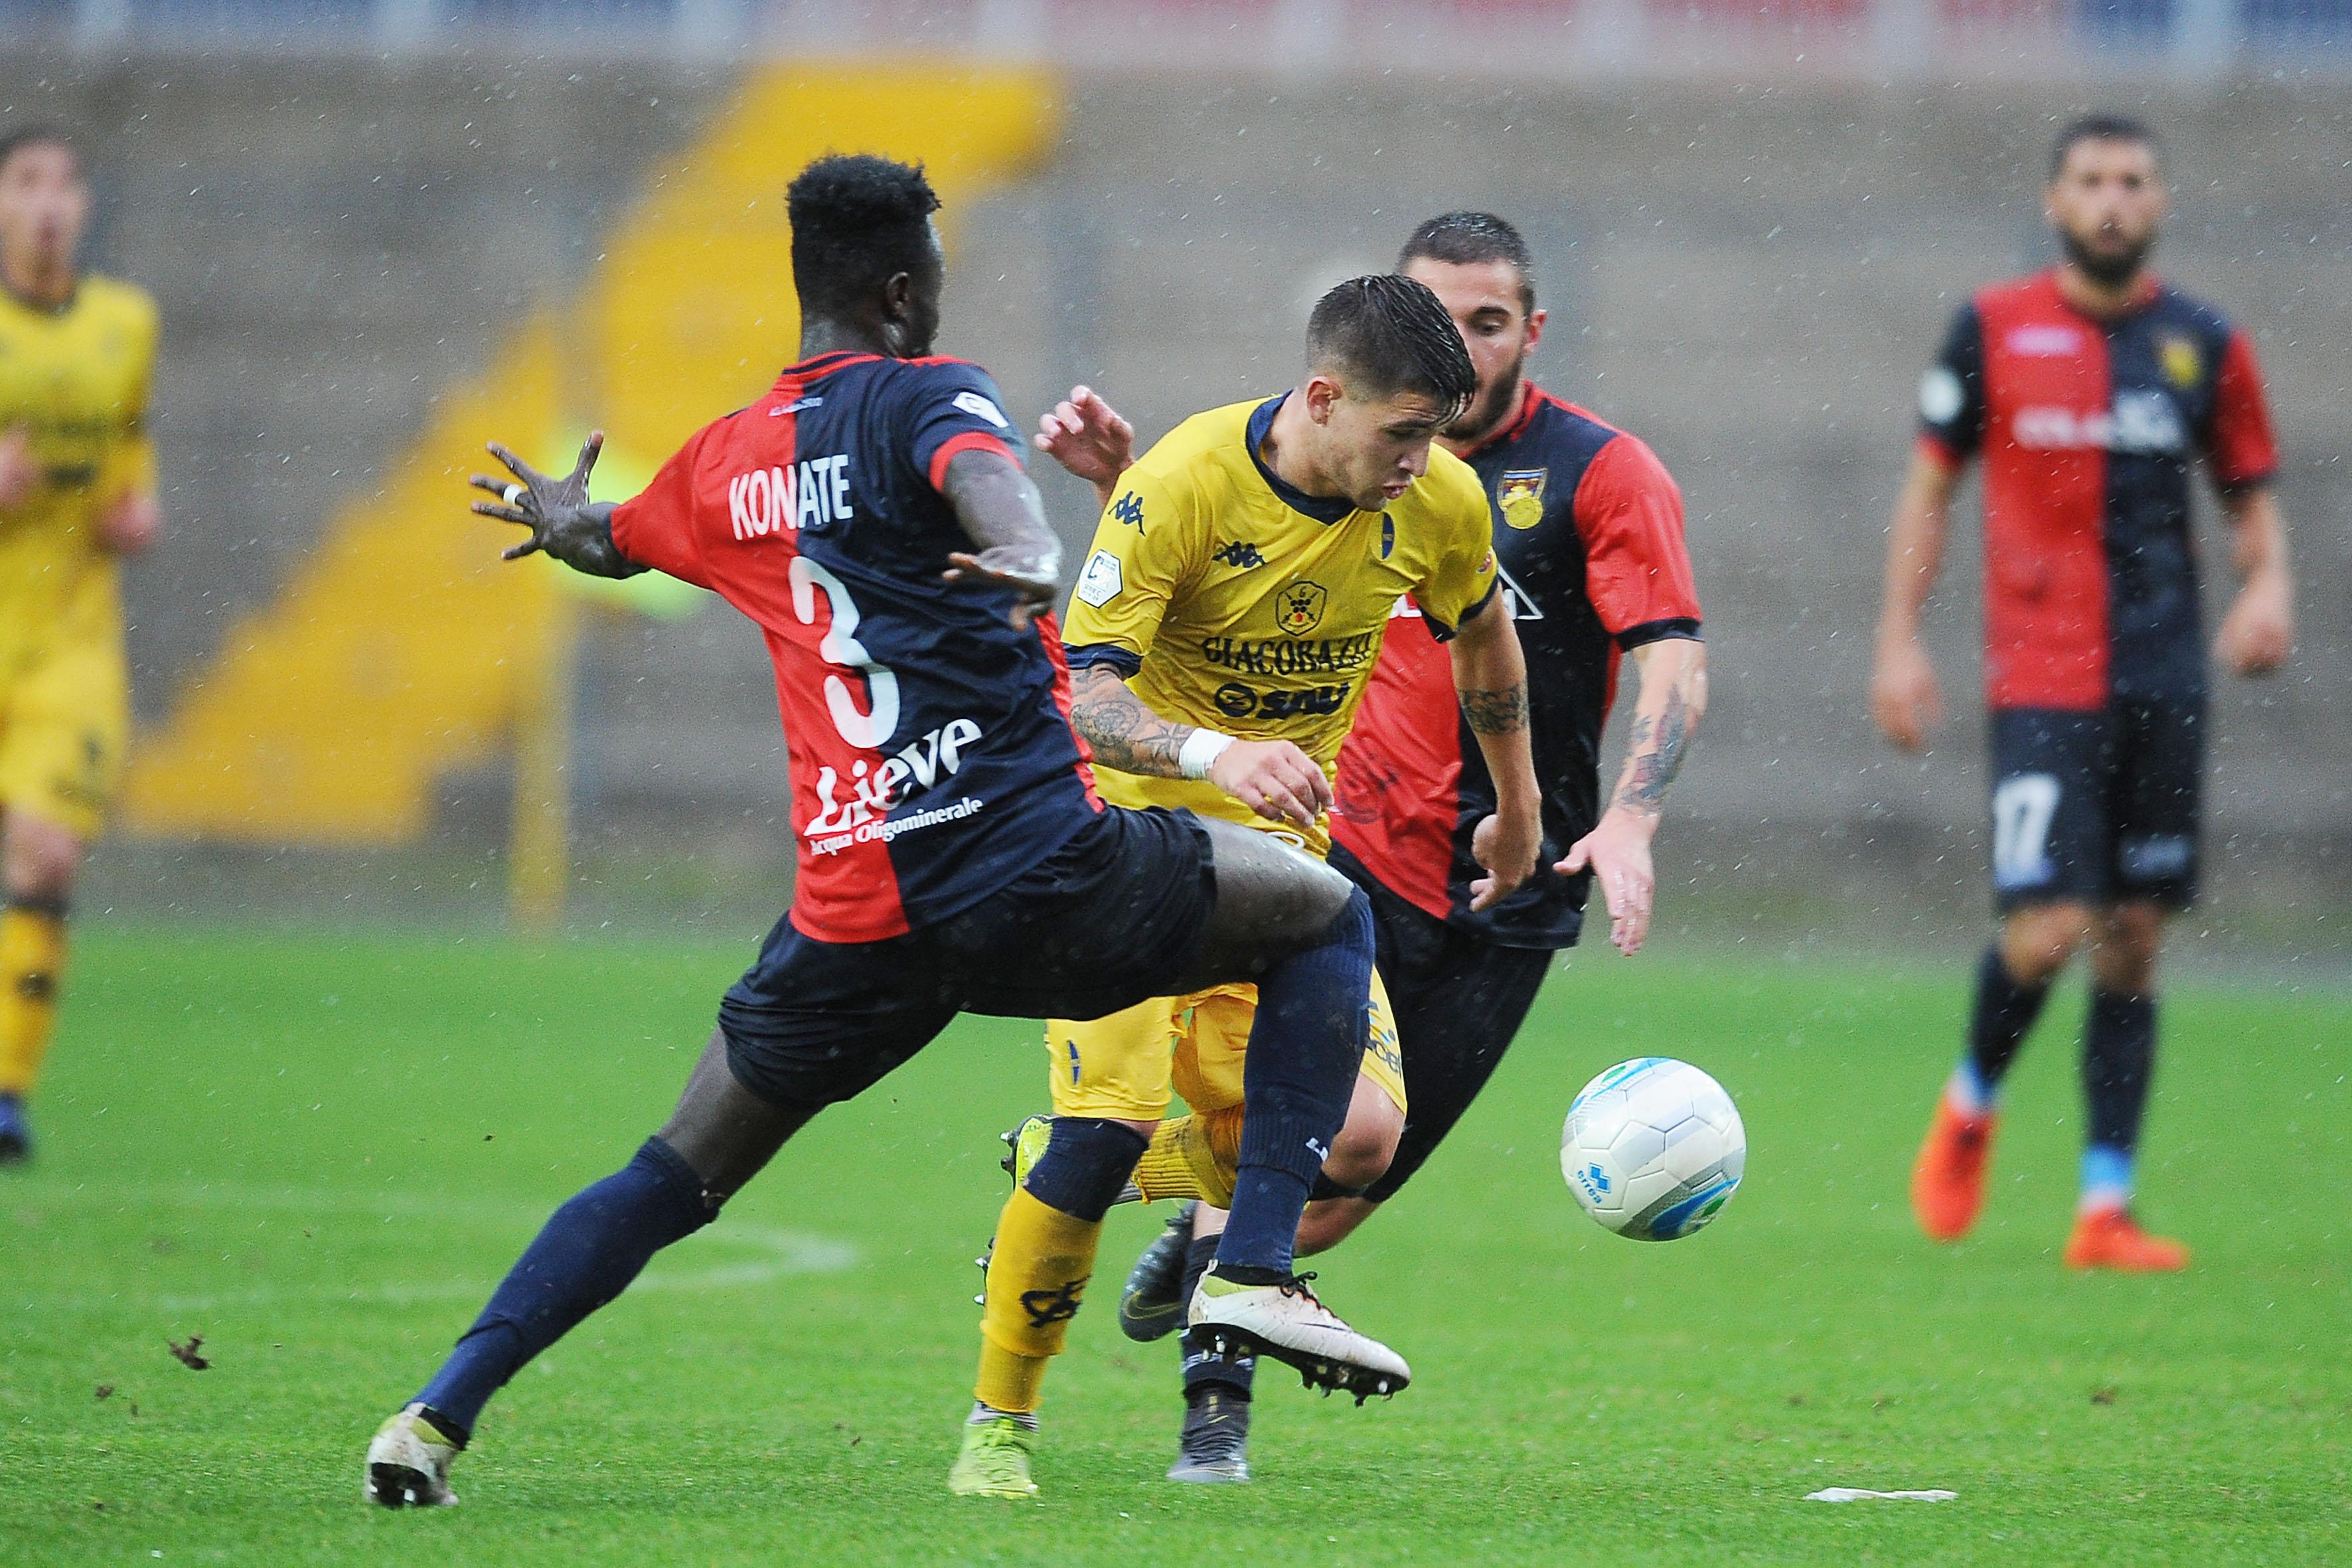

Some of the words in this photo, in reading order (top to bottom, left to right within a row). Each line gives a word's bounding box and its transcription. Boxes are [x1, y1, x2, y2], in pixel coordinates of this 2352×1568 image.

[729, 454, 853, 540] KONATE
[789, 556, 900, 748] 3
[803, 718, 983, 837] Lieve
[854, 796, 983, 842] Oligominerale
